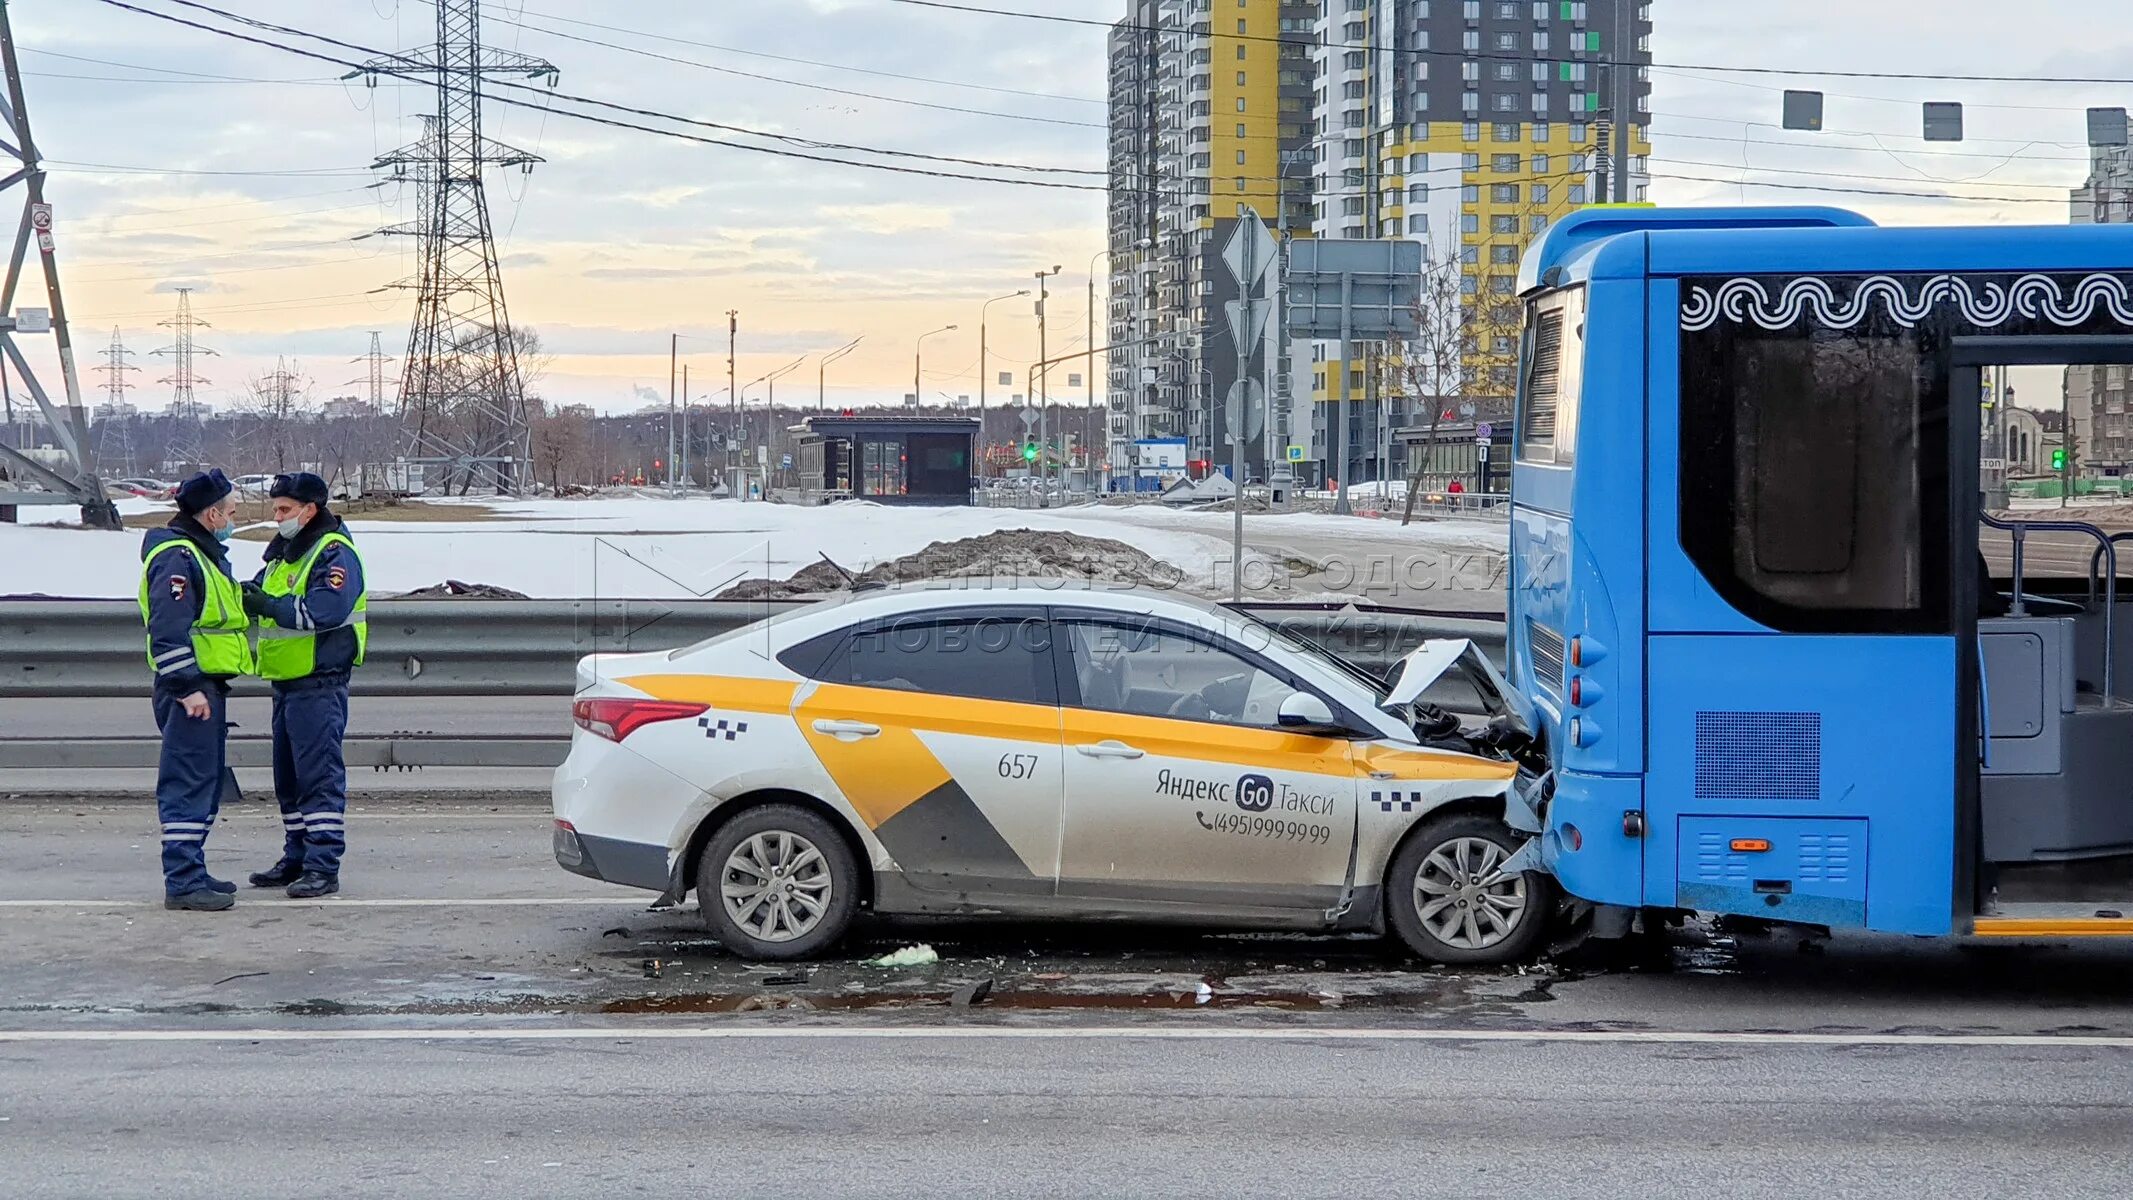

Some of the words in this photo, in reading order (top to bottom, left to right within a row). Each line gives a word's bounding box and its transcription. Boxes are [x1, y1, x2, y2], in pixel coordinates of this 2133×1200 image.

[997, 752, 1039, 779] 657
[1155, 768, 1230, 803] Яндекс
[1240, 777, 1269, 807] Go
[1279, 783, 1335, 816] Такси
